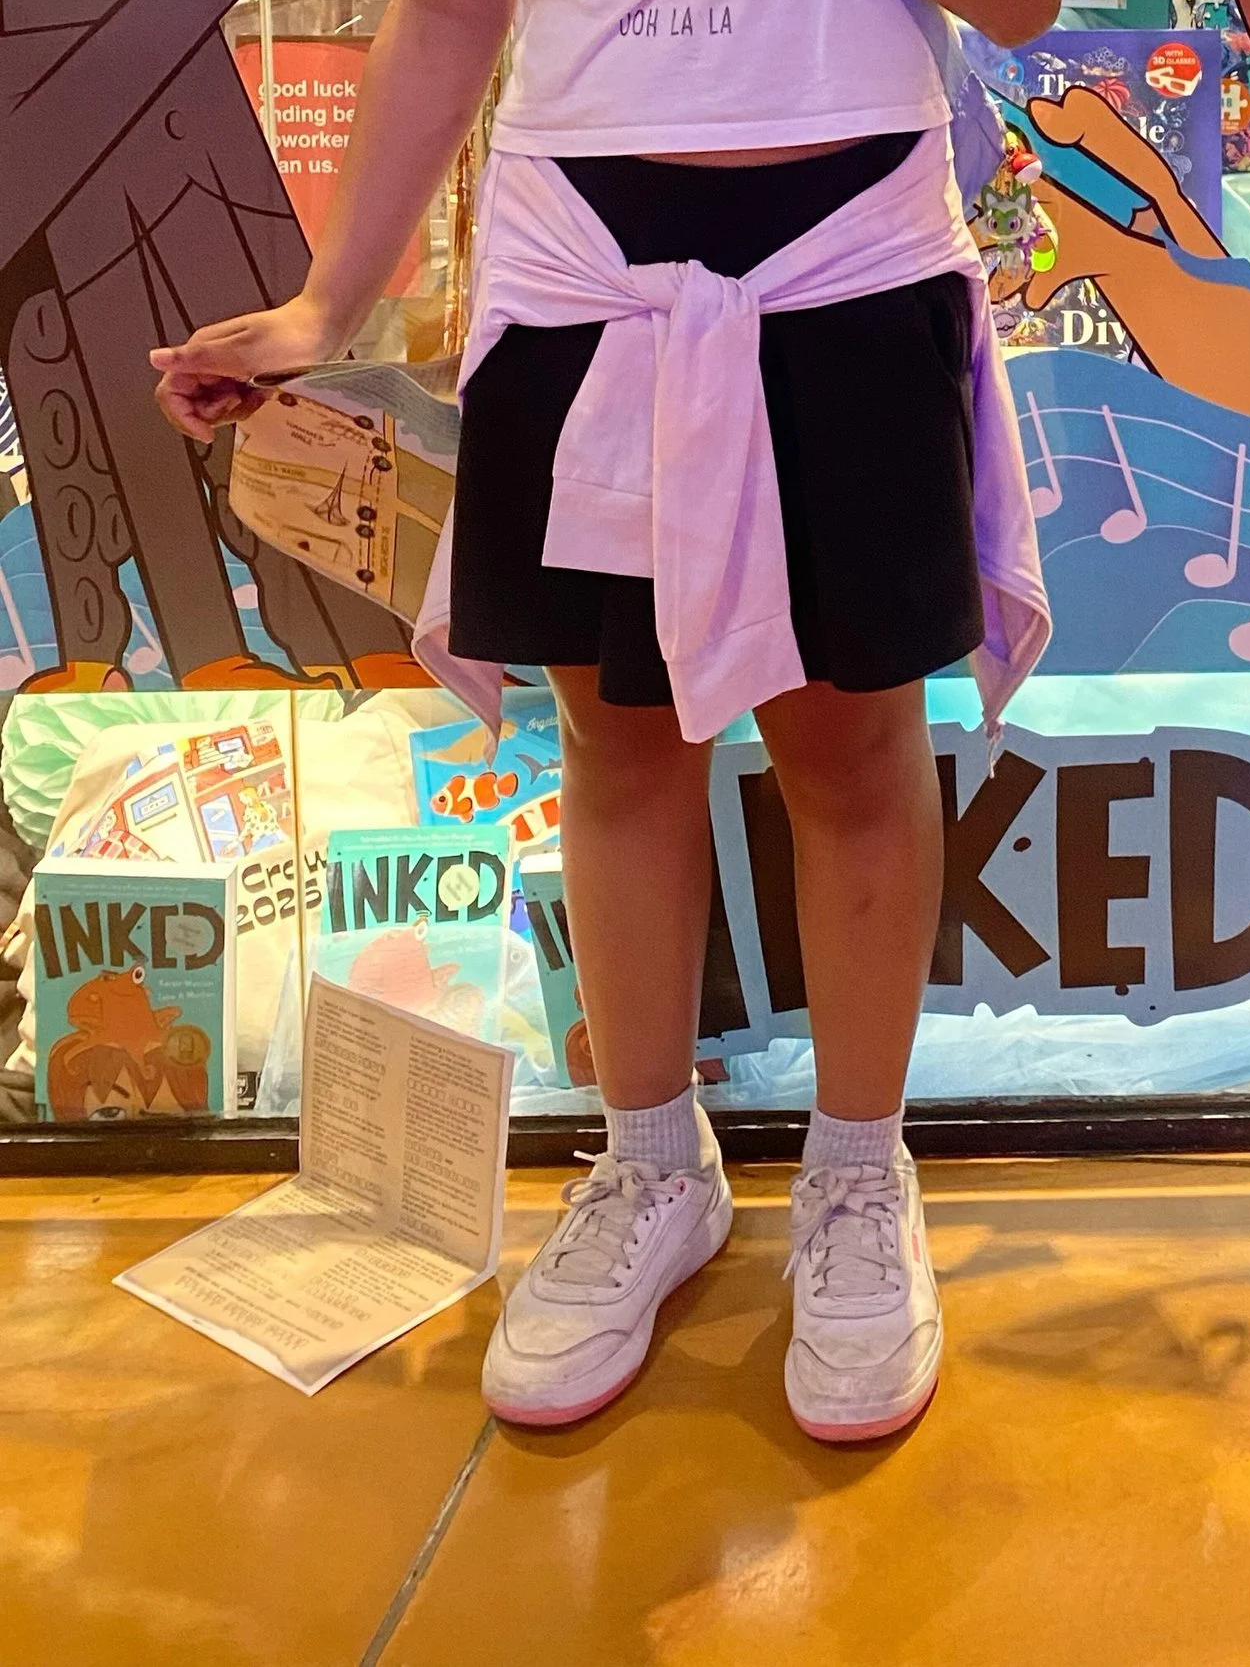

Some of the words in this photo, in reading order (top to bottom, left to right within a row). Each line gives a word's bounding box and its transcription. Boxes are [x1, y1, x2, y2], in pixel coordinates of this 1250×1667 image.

[671, 7, 693, 36] LA
[710, 6, 732, 35] LA
[1153, 56, 1166, 65] 3D
[1166, 57, 1197, 65] GLASSES
[314, 80, 357, 97] luck
[308, 159, 339, 173] us.
[237, 878, 322, 935] 2025
[35, 901, 225, 979] INKED
